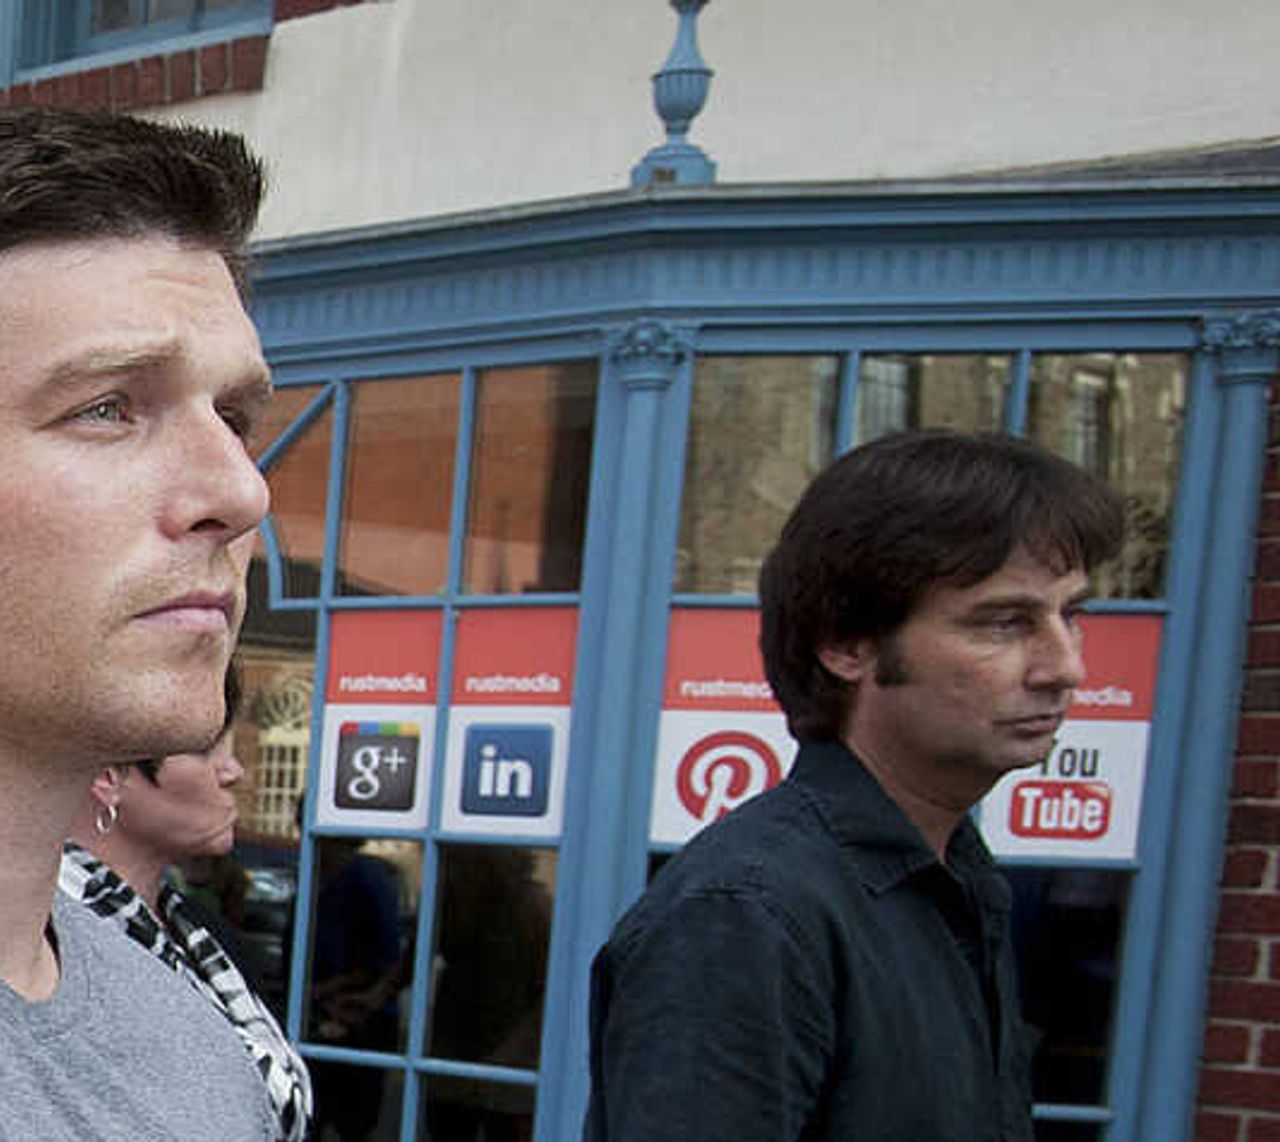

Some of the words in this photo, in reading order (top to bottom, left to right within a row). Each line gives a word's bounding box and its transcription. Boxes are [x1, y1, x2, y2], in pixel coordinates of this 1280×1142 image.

[339, 672, 427, 693] rustmedia
[465, 673, 561, 693] rustmedia
[478, 745, 533, 797] in
[1018, 786, 1105, 831] Tube
